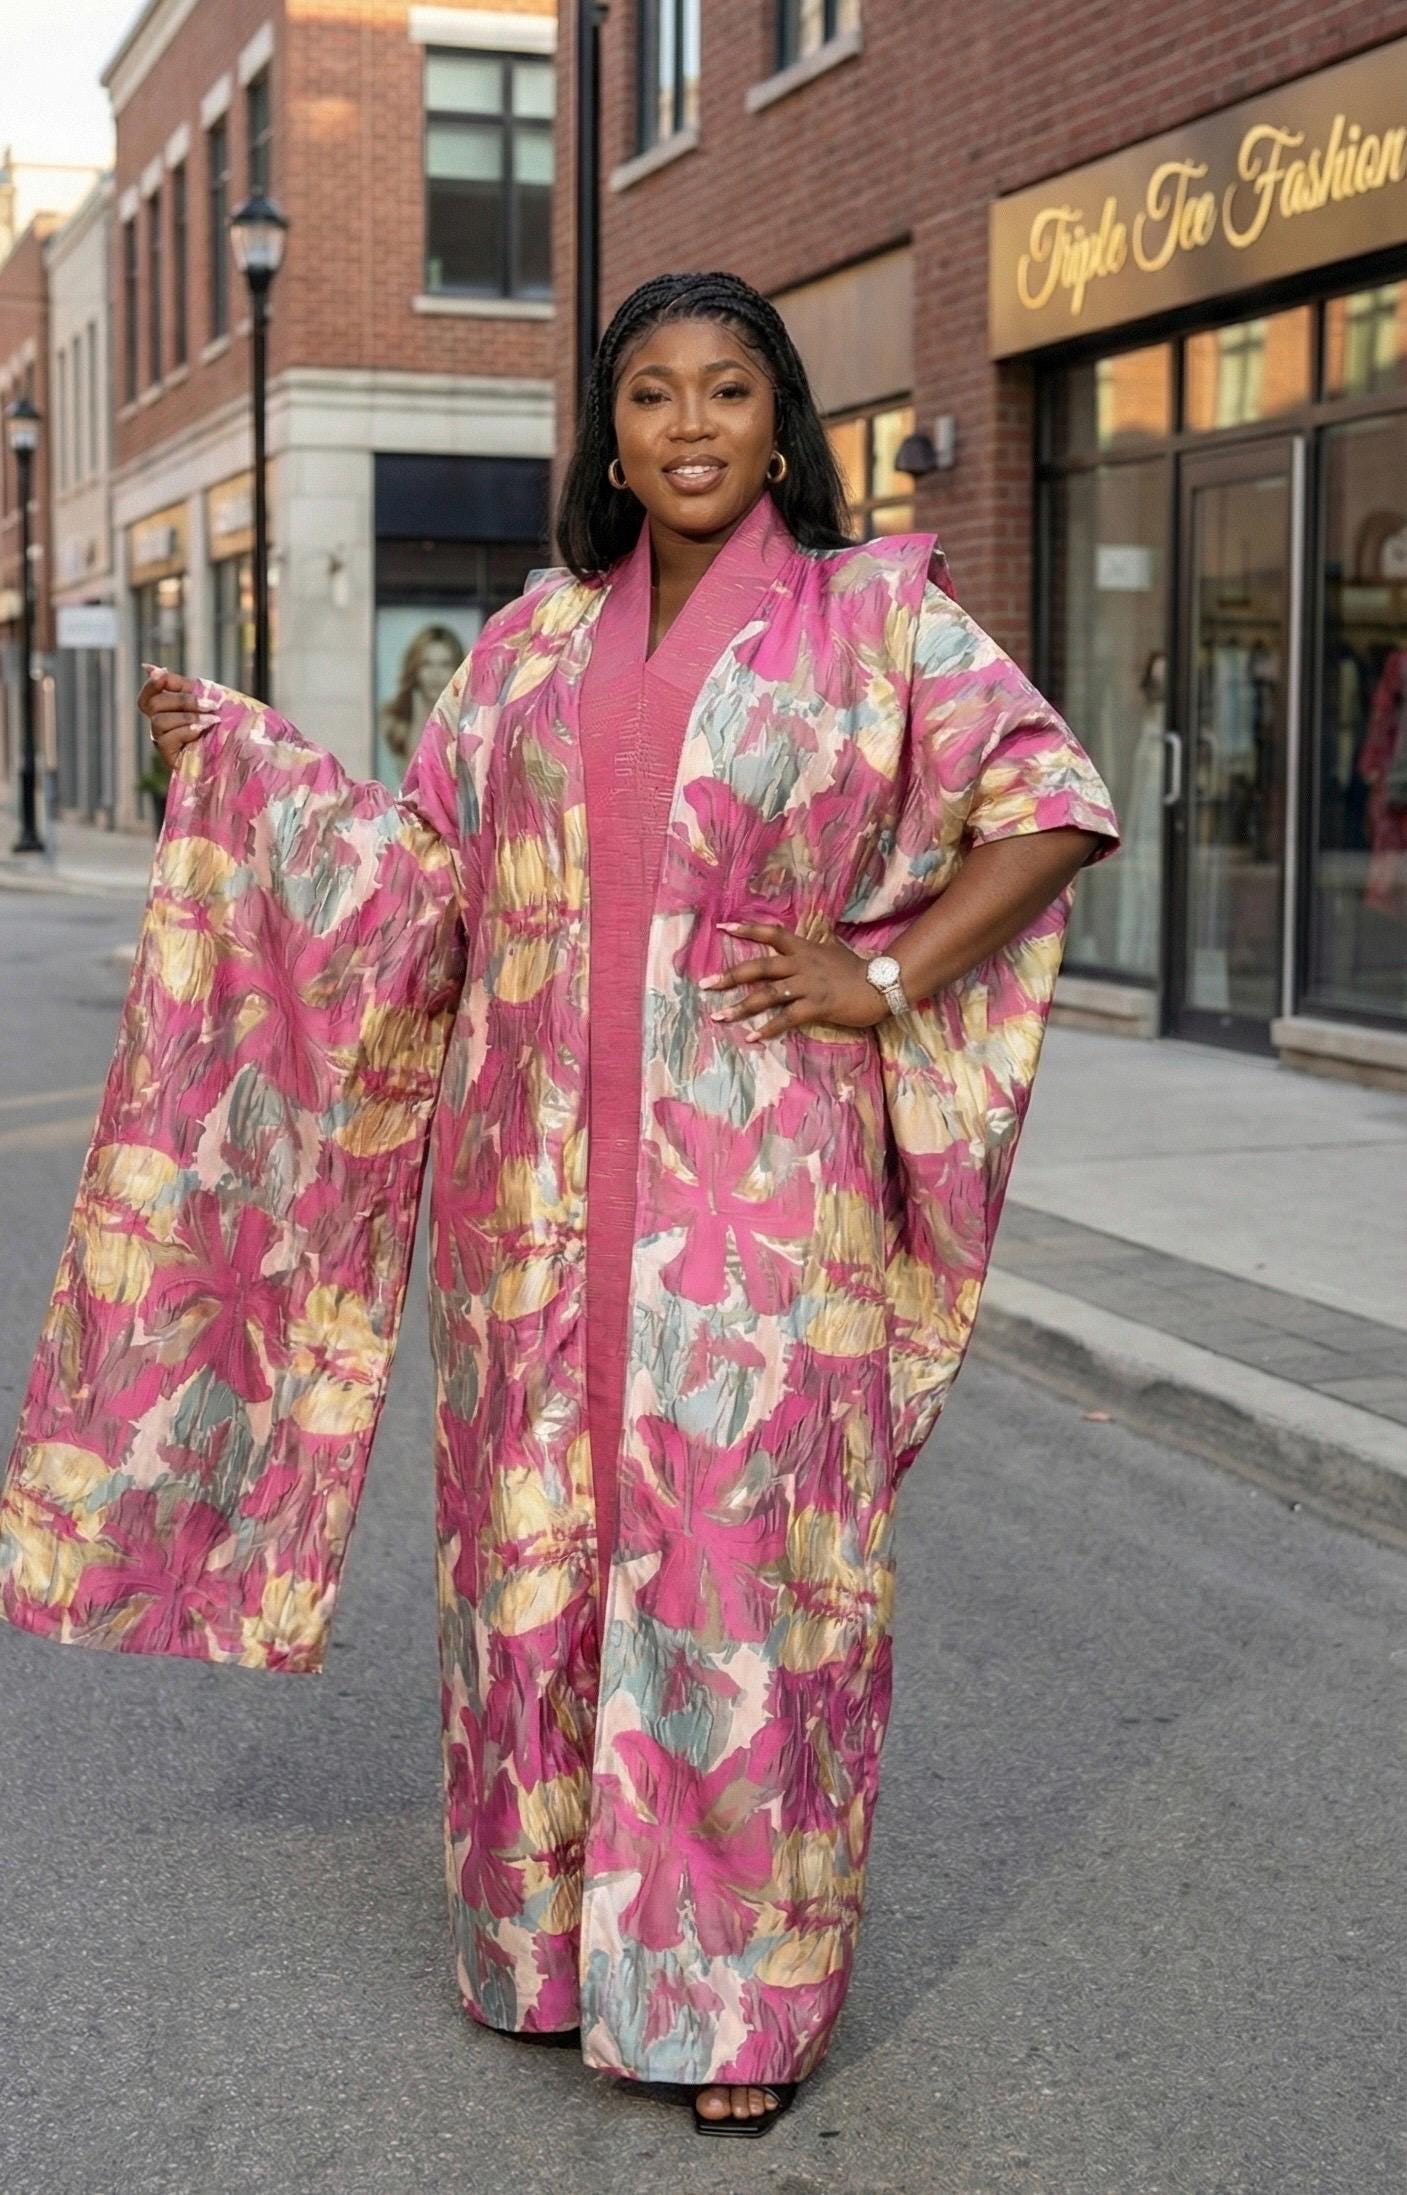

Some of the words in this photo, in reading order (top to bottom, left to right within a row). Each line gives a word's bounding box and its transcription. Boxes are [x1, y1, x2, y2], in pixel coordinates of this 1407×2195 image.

[1017, 196, 1128, 316] Triple
[1132, 158, 1218, 272] Tee
[1222, 112, 1407, 248] Fashion
